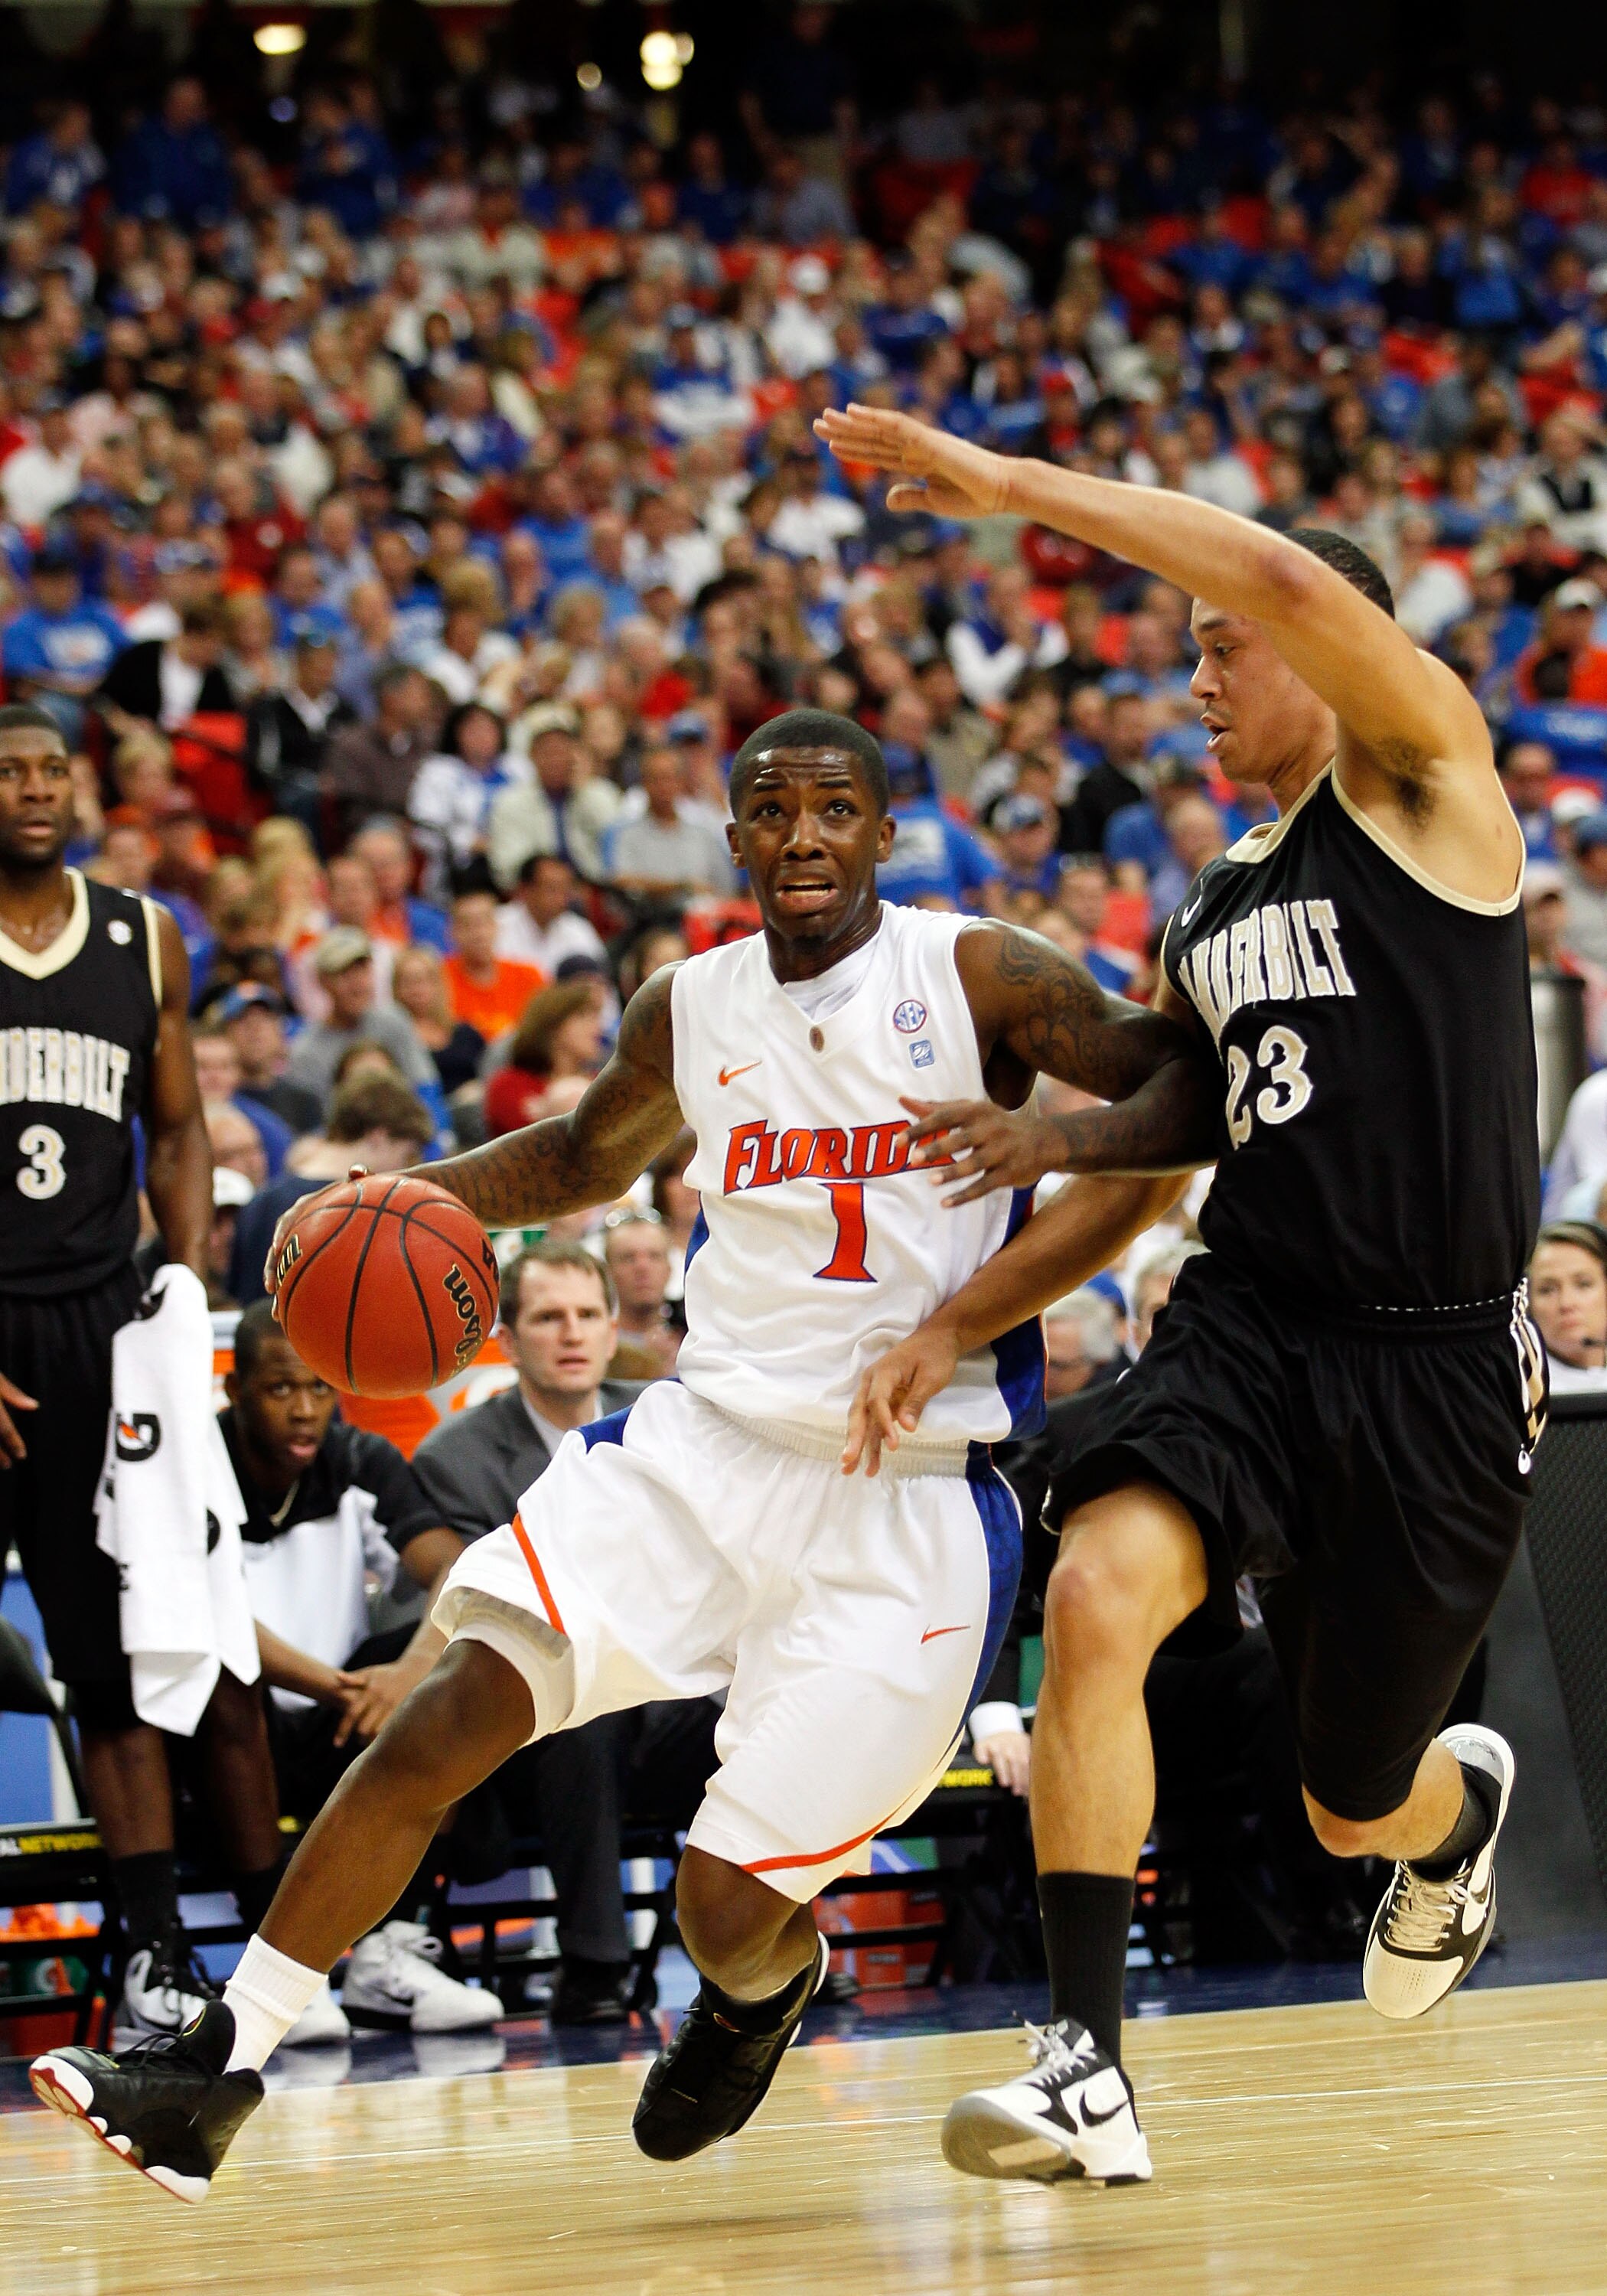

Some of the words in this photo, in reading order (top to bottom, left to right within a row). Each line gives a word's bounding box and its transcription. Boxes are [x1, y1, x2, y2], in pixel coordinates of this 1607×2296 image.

[1225, 1025, 1314, 1150] 23
[16, 1124, 67, 1200] 3
[812, 1182, 878, 1283] 1
[442, 1262, 483, 1378] lson
